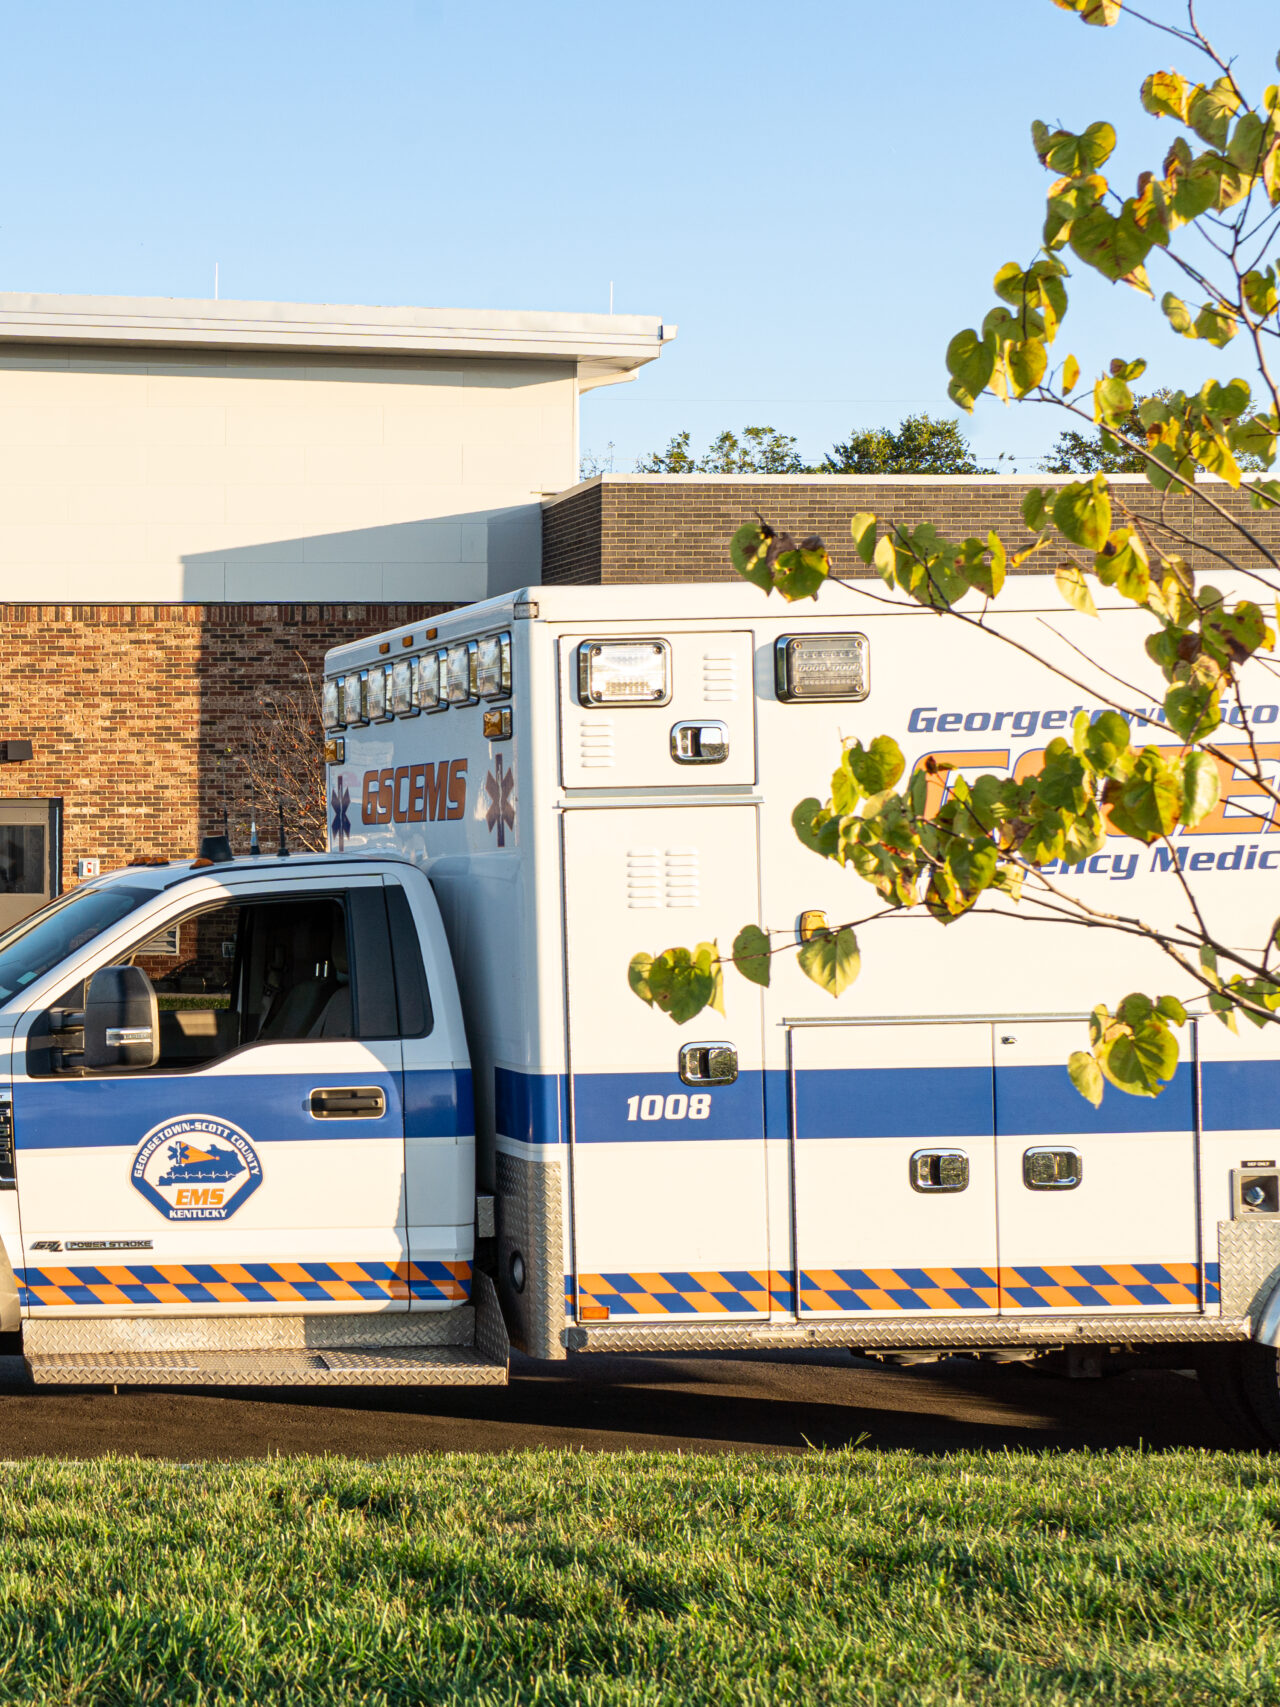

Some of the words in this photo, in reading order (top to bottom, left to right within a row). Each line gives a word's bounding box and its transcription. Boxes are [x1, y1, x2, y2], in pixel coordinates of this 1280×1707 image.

[362, 757, 468, 826] GSCEMS
[1149, 845, 1280, 872] Medic
[627, 1093, 712, 1121] 1008
[230, 1135, 261, 1176] COUNTY
[175, 1188, 225, 1206] EMS
[169, 1209, 228, 1219] KENTUCKY
[70, 1241, 107, 1249] POWER
[109, 1240, 152, 1248] STROKE
